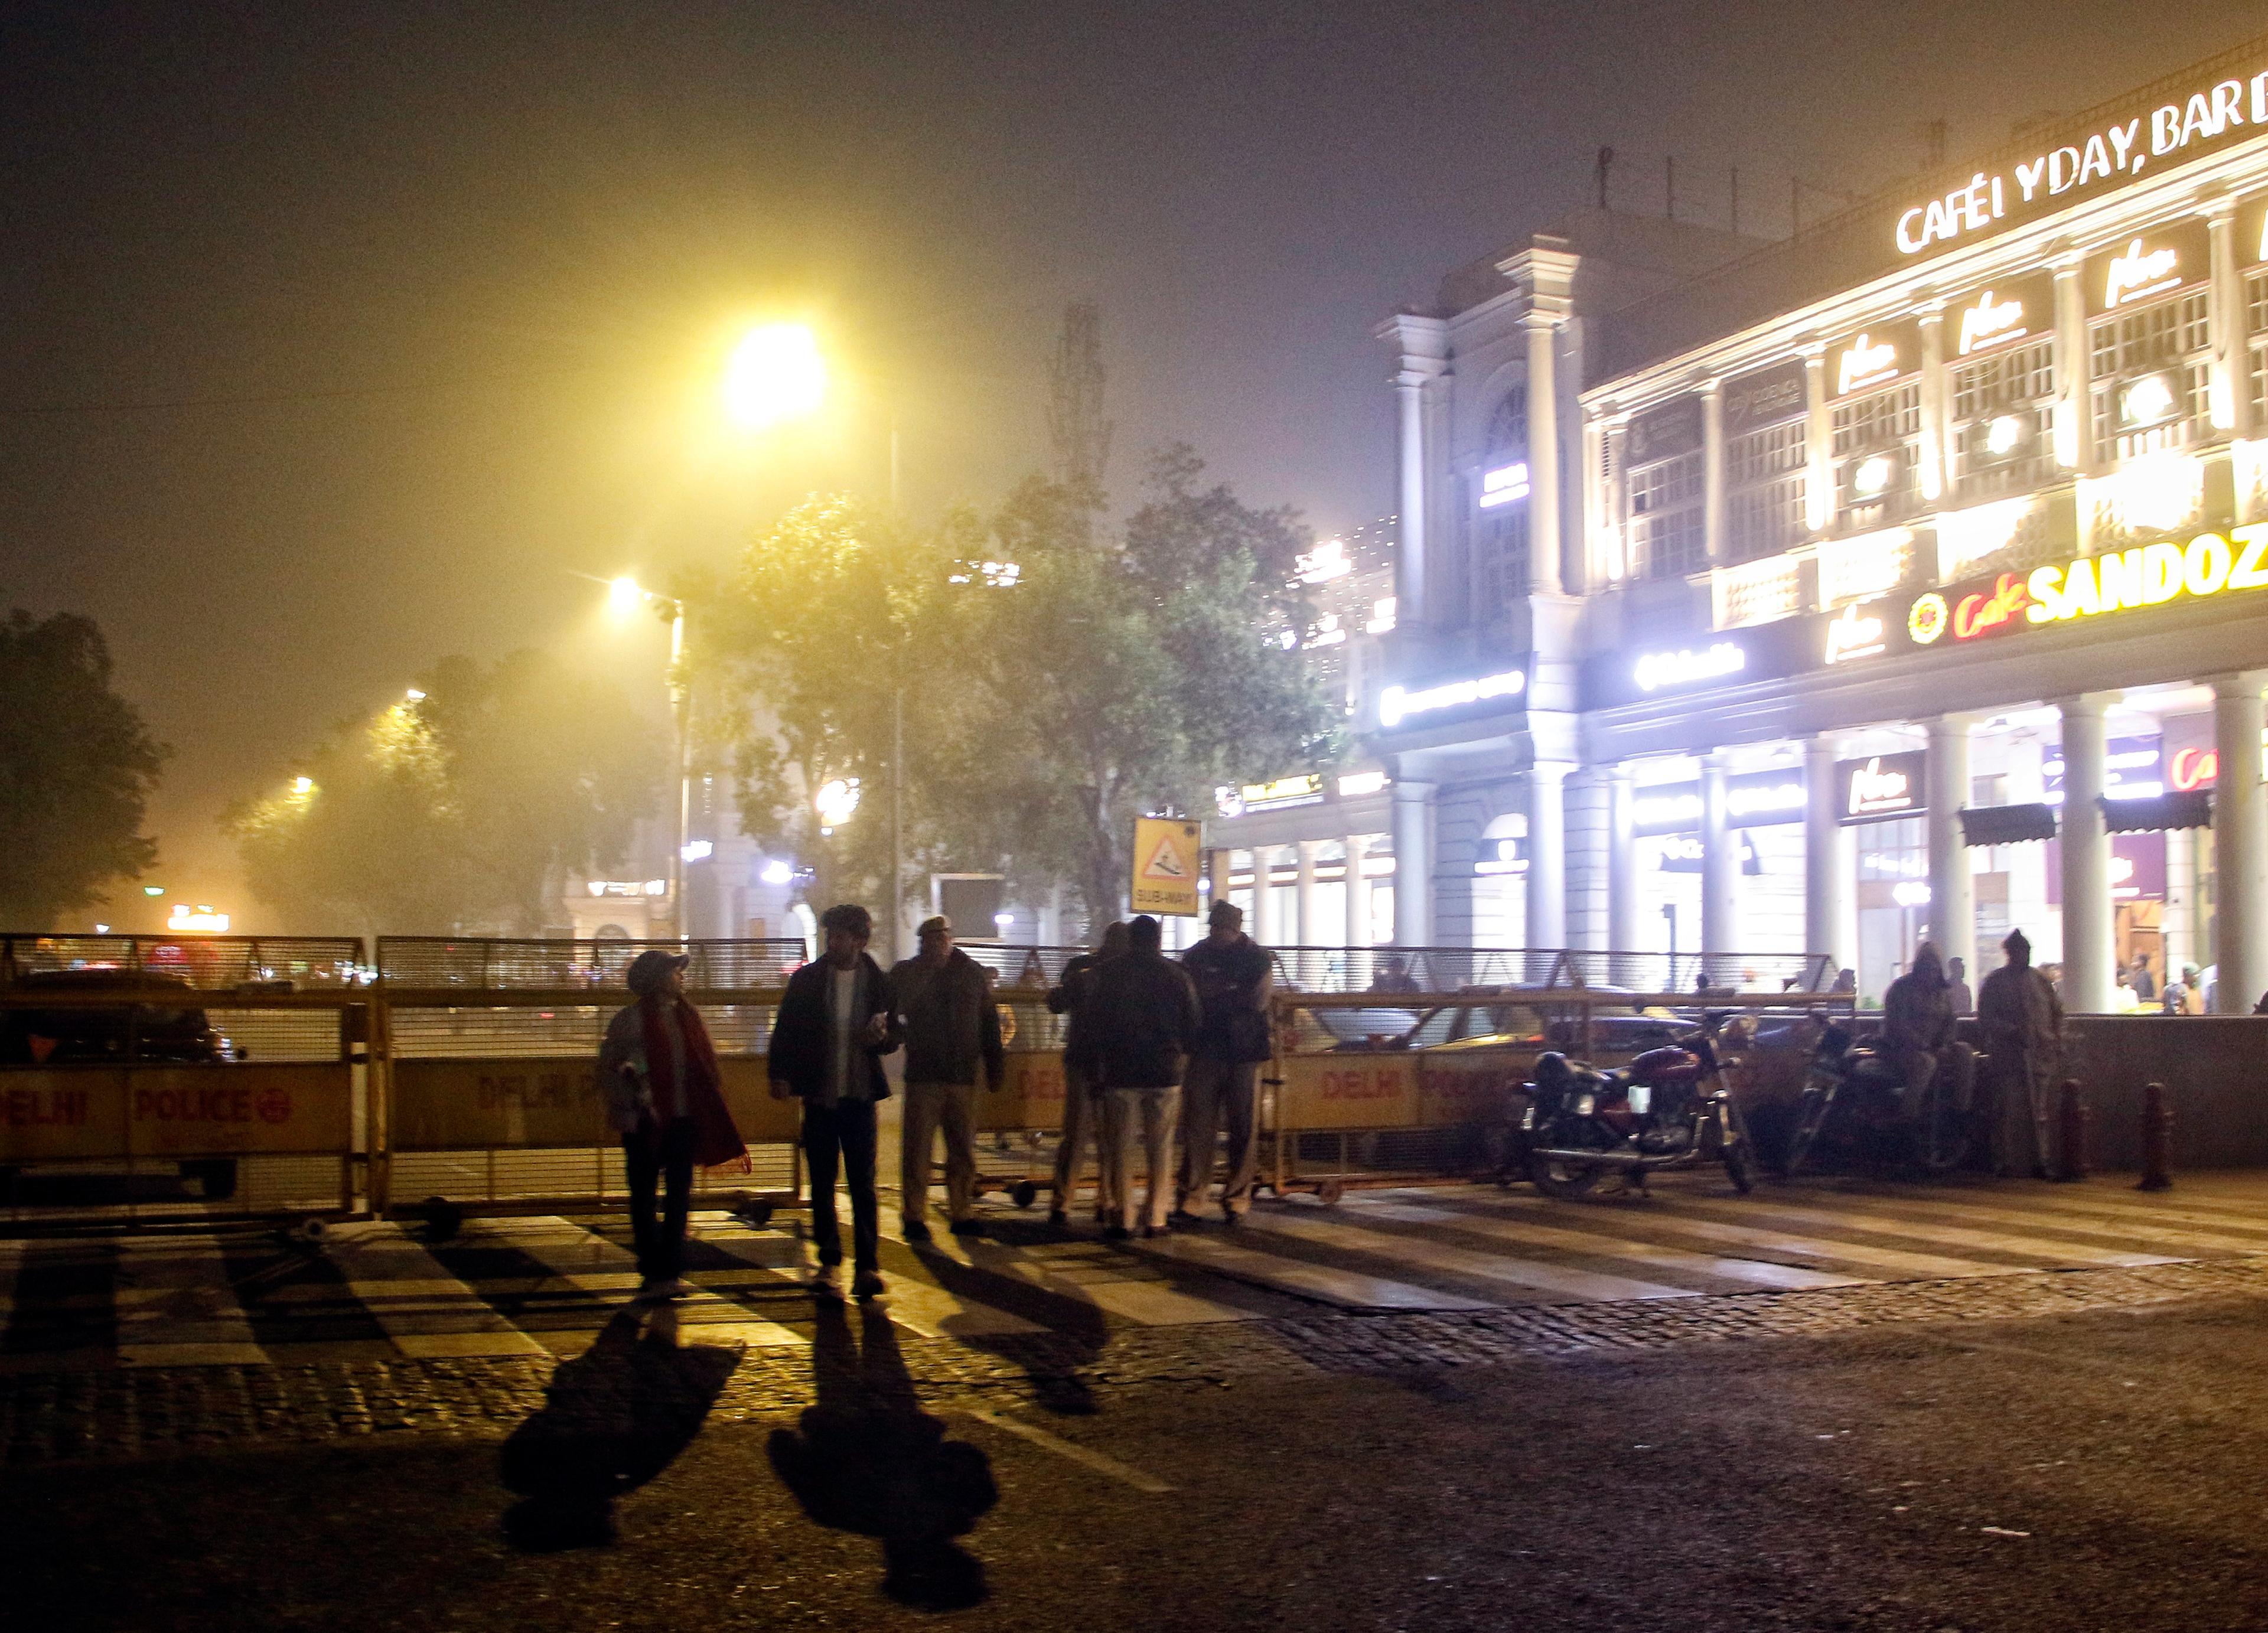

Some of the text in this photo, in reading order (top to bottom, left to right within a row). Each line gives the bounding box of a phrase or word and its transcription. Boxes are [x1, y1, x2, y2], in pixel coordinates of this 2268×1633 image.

[2151, 79, 2244, 157] BAR
[2026, 521, 2268, 624] SANDOZ
[1017, 1069, 1064, 1100] DEL
[1322, 1070, 1402, 1100] DELHI
[0, 1088, 252, 1126] ELHI POLICE
